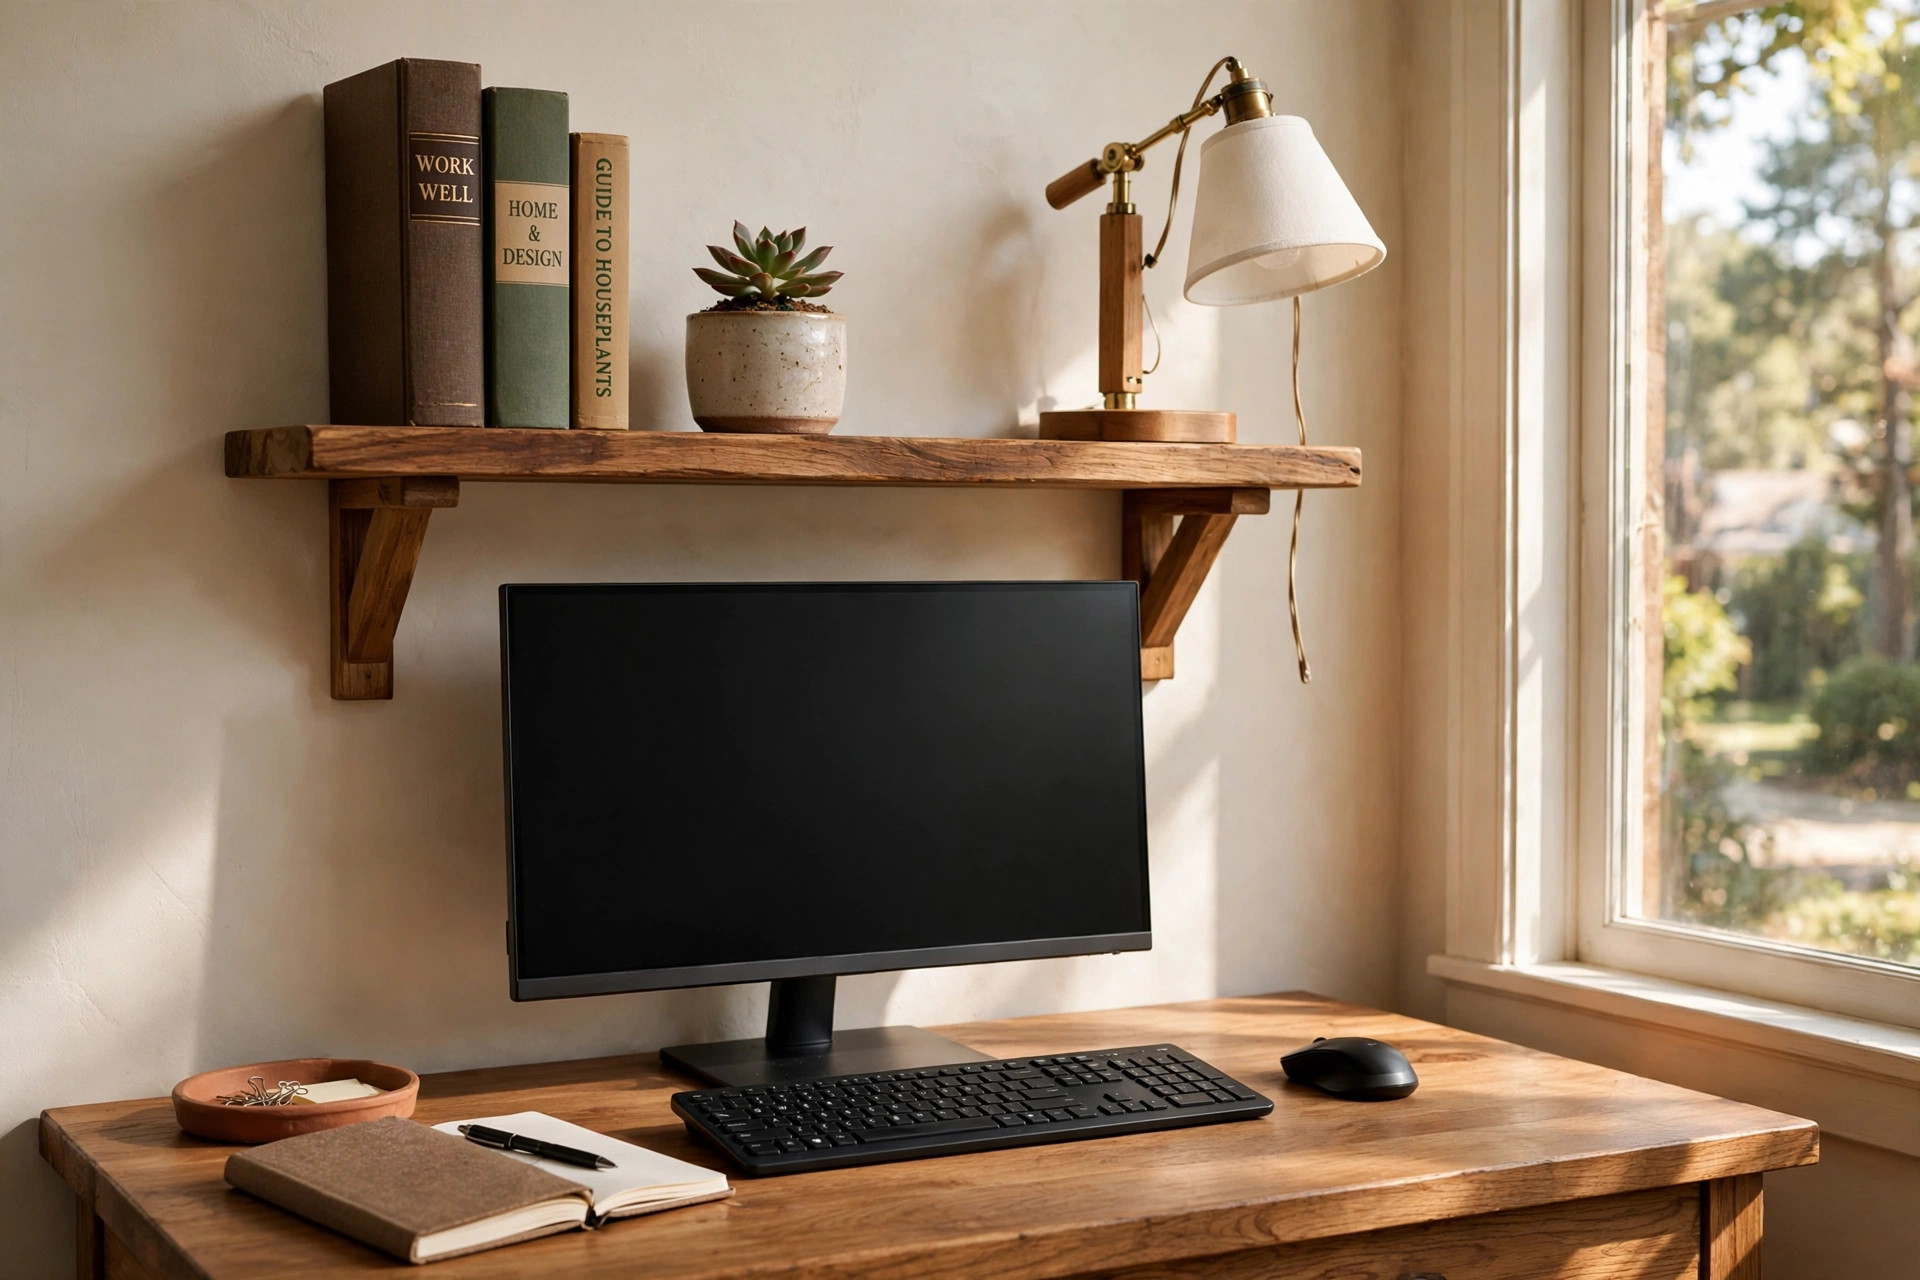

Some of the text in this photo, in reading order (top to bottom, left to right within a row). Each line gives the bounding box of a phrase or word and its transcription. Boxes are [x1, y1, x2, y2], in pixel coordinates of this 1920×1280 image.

[415, 154, 475, 175] WORK
[418, 183, 474, 203] WELL
[508, 200, 558, 219] HOME
[528, 224, 541, 242] &
[502, 248, 563, 267] DESIGN
[595, 157, 612, 398] GUIDE TO HOUSEPLANTS
